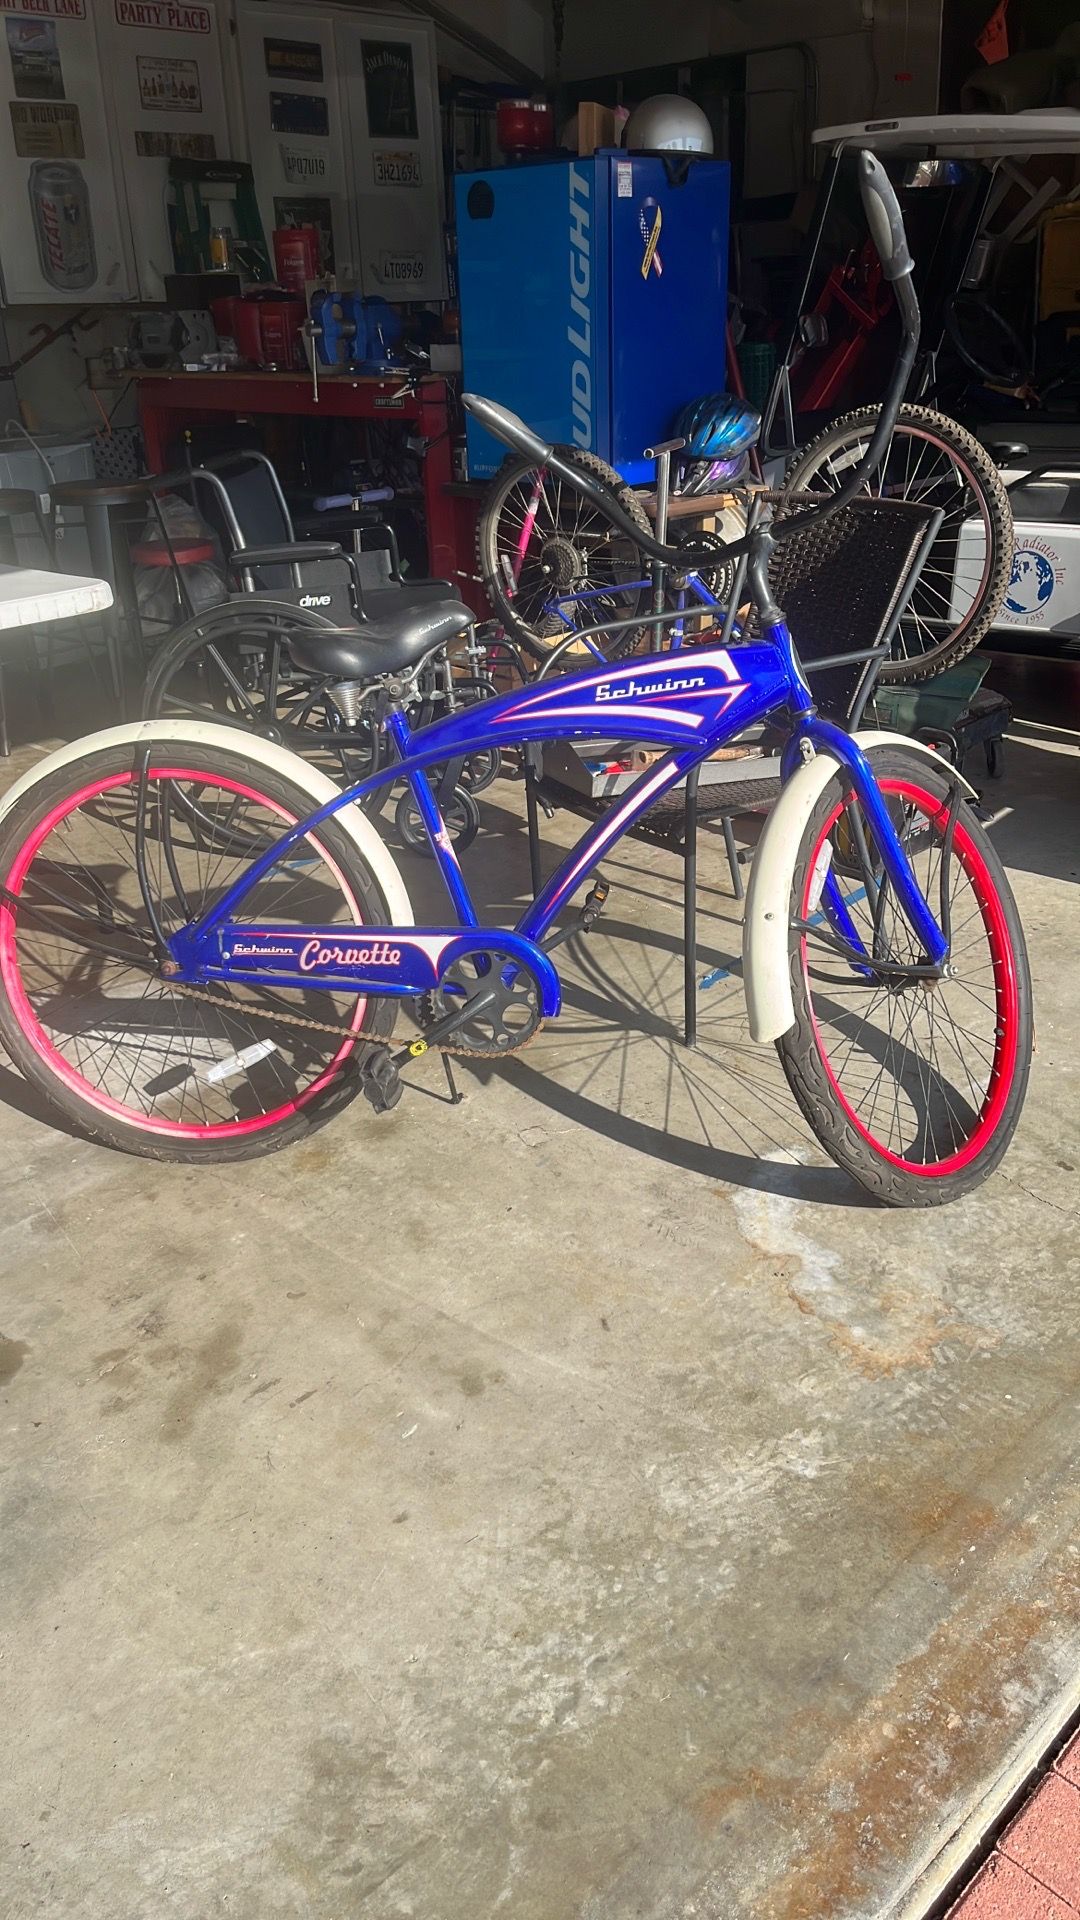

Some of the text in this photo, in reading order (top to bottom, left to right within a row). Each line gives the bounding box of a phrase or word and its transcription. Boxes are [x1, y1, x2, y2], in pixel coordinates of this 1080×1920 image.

[119, 2, 208, 31] PARTY PLACE
[40, 197, 66, 272] TECATE
[383, 260, 425, 280] 4T08969
[567, 160, 592, 453] UD LIGHT
[1013, 535, 1061, 563] Radiator
[299, 594, 332, 608] drive
[418, 615, 453, 636] Schwinn
[997, 607, 1046, 626] Since 1955
[594, 677, 707, 703] Schwinn
[233, 939, 401, 971] Schwinn Corvette
